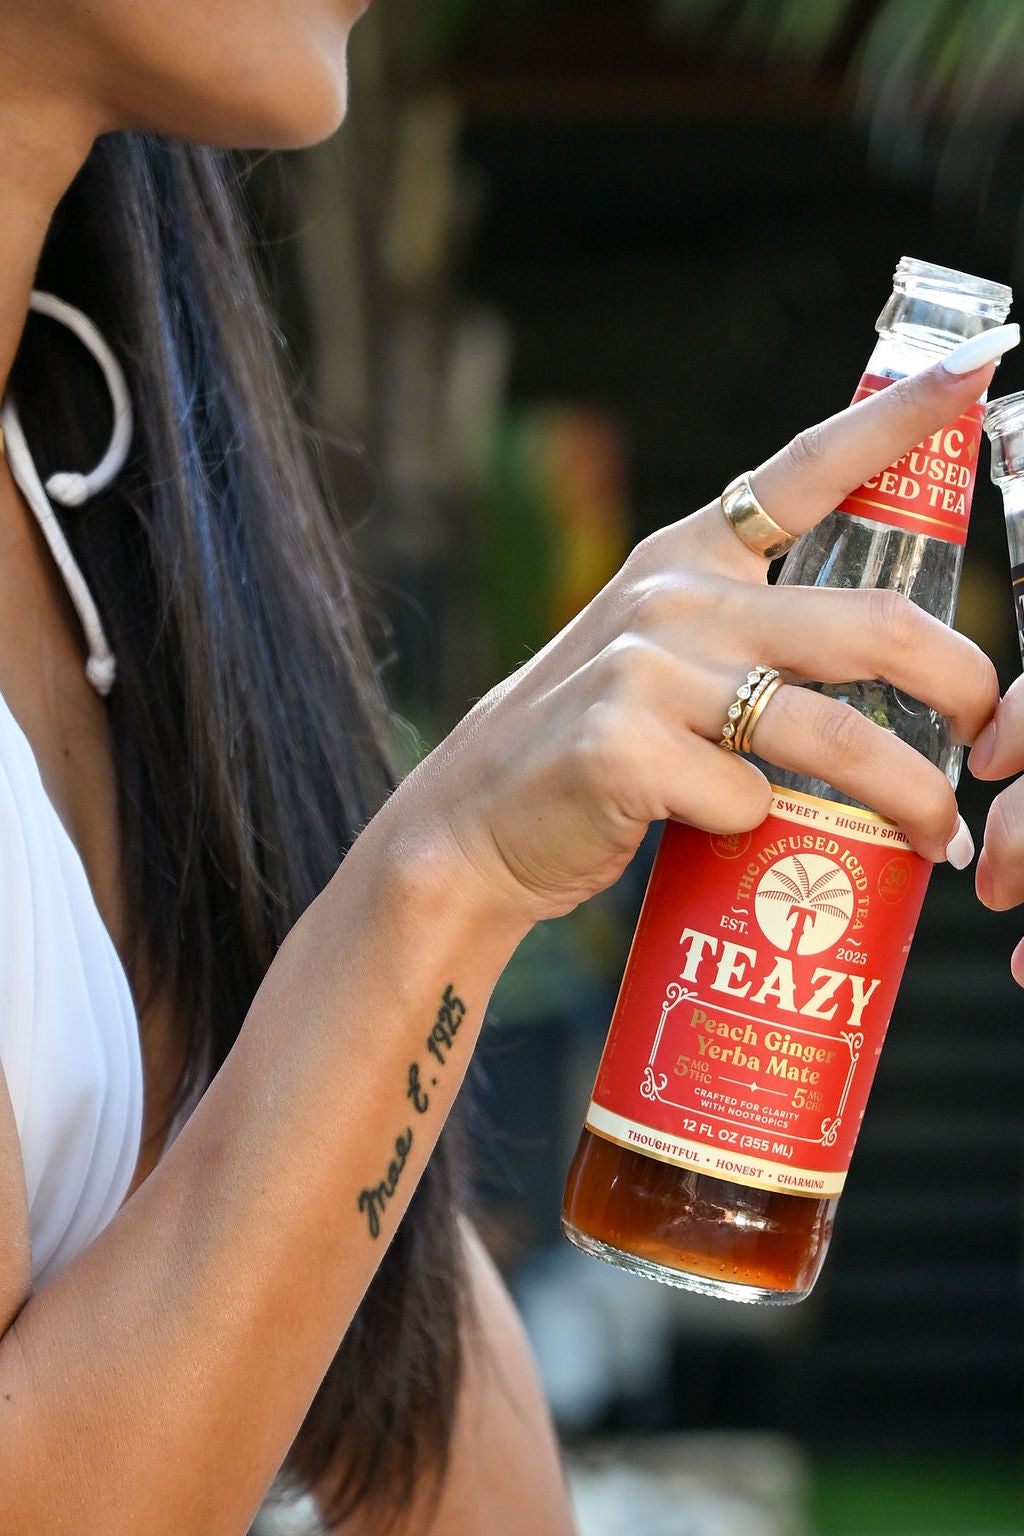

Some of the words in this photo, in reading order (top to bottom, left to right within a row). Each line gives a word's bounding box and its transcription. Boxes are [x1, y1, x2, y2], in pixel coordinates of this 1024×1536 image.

[927, 484, 965, 515] TEA
[777, 800, 820, 820] SWEET
[836, 816, 880, 836] HIGHLY
[760, 835, 839, 865] INFUSED
[839, 850, 868, 891] ICED
[736, 862, 760, 900] THC
[852, 895, 870, 930] TEA
[720, 916, 749, 934] EST.
[836, 948, 868, 964] 2025
[678, 928, 881, 1026] TEAZY
[427, 983, 466, 1065] 1925
[689, 1007, 757, 1047] Peach
[764, 1028, 836, 1064] Ginger
[696, 1035, 760, 1071] Yerba
[765, 1056, 821, 1085] Mate
[694, 1087, 737, 1106] CRAFTED
[740, 1099, 759, 1112] FOR
[762, 1105, 800, 1121] CLARITY
[701, 1099, 725, 1114] WITH
[727, 1107, 788, 1129] NOOTROPICS
[627, 1129, 700, 1162] THOUGHTFUL
[716, 1159, 763, 1179] HONEST
[777, 1174, 824, 1189] CHARMING
[682, 1118, 696, 1132] 12
[699, 1123, 716, 1137] FL
[719, 1128, 738, 1144] OZ
[740, 1133, 769, 1152] (355
[771, 1141, 794, 1159] ML)
